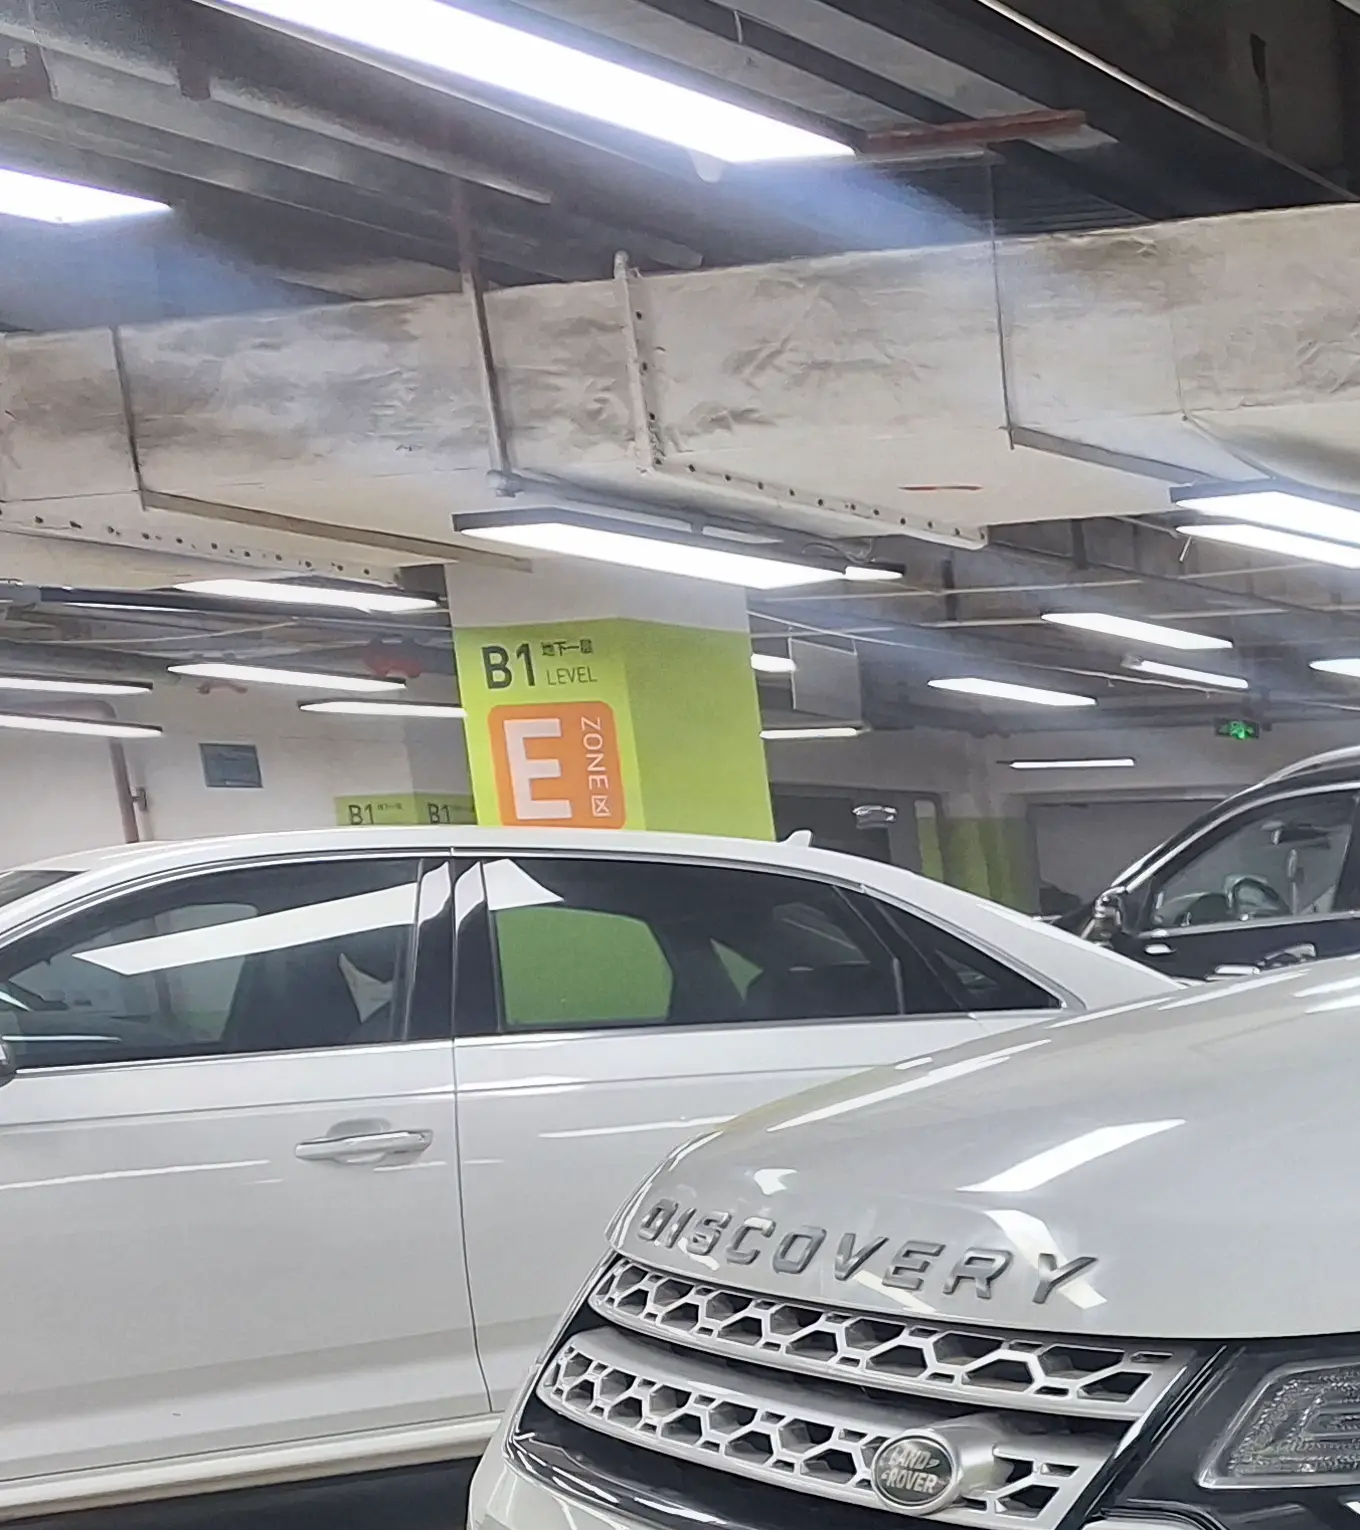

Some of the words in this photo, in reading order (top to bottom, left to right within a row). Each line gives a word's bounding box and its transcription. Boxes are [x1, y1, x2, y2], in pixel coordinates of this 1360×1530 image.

[481, 643, 536, 689] B1
[545, 665, 598, 685] LEVEL
[581, 716, 609, 791] ZONE
[503, 717, 573, 820] E
[347, 803, 375, 825] B1
[427, 802, 451, 825] B1
[637, 1198, 1098, 1304] DISCOVERY
[887, 1443, 932, 1470] LAND
[885, 1467, 939, 1494] ROVER
